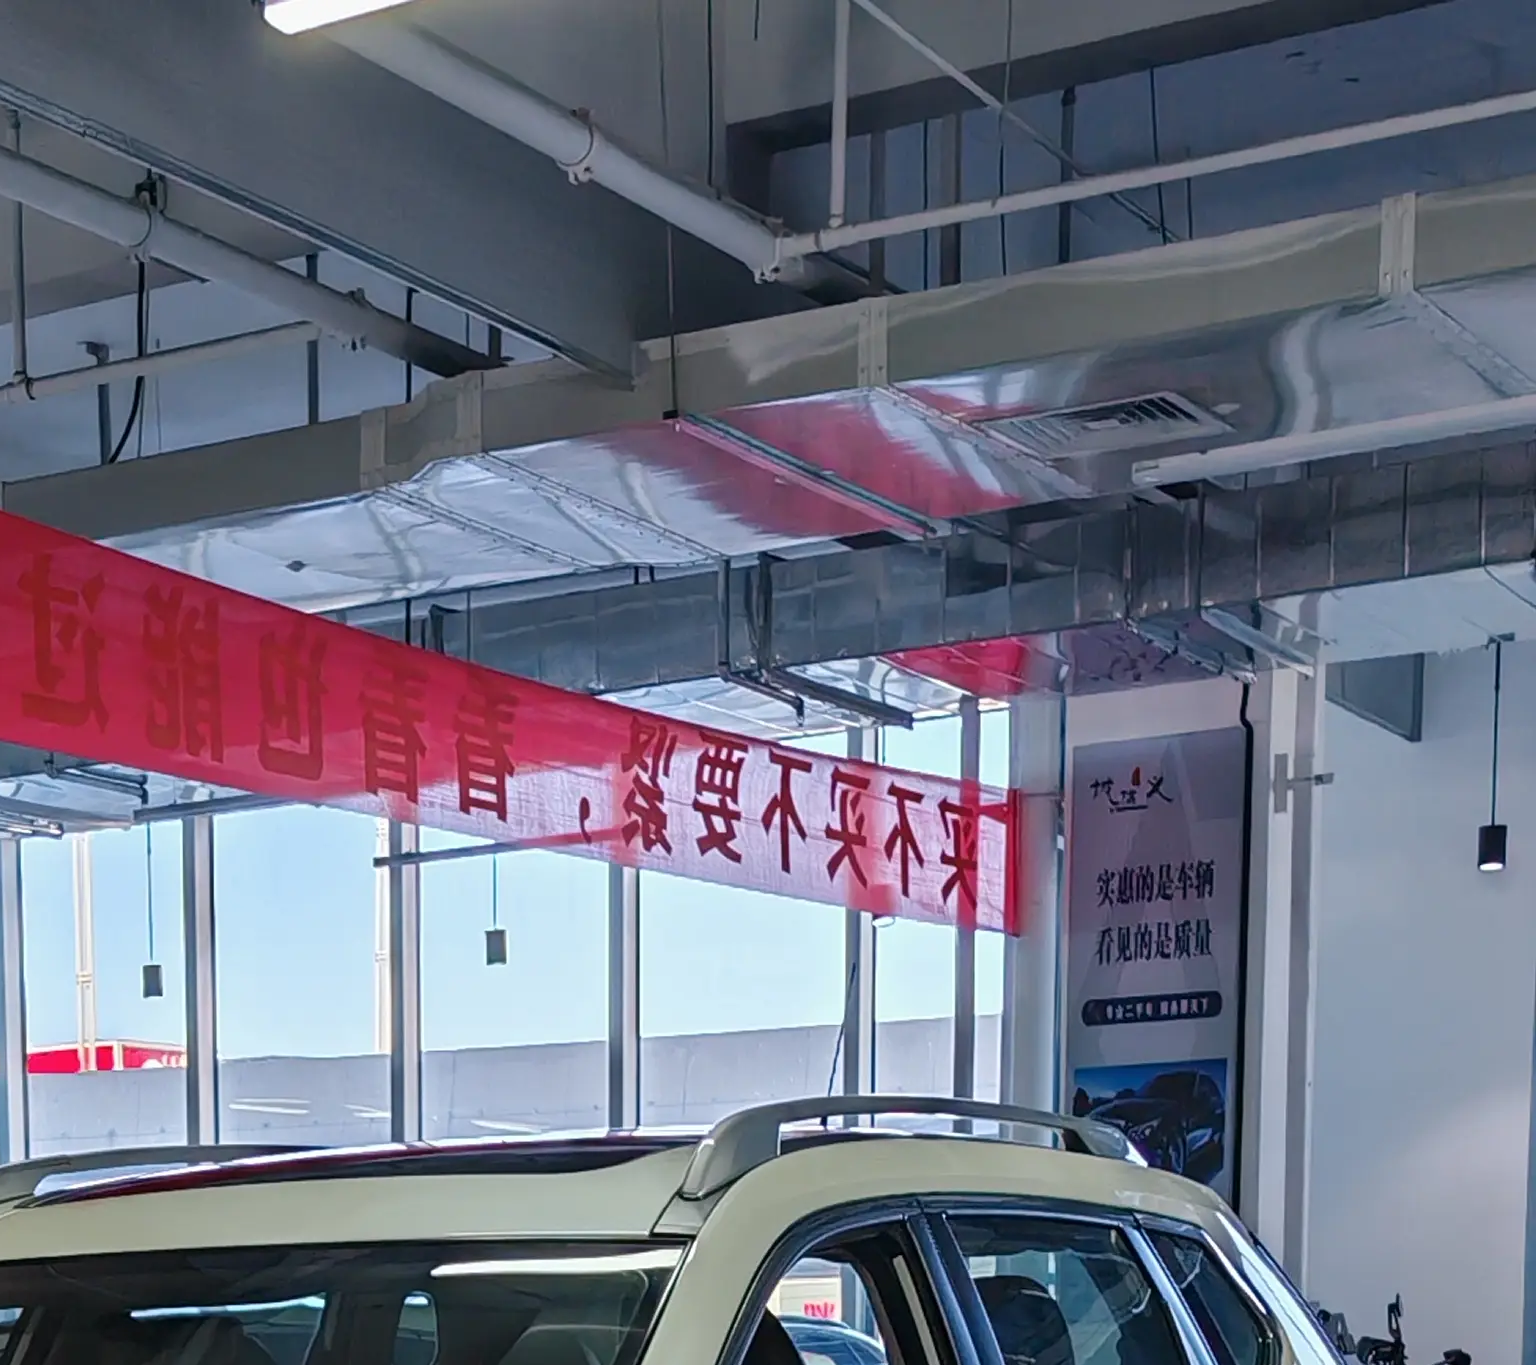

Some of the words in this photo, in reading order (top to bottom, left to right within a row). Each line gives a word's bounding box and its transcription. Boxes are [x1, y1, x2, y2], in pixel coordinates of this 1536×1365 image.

[1096, 858, 1215, 908] 实惠的是车辆
[1094, 918, 1213, 966] 看见的是质量
